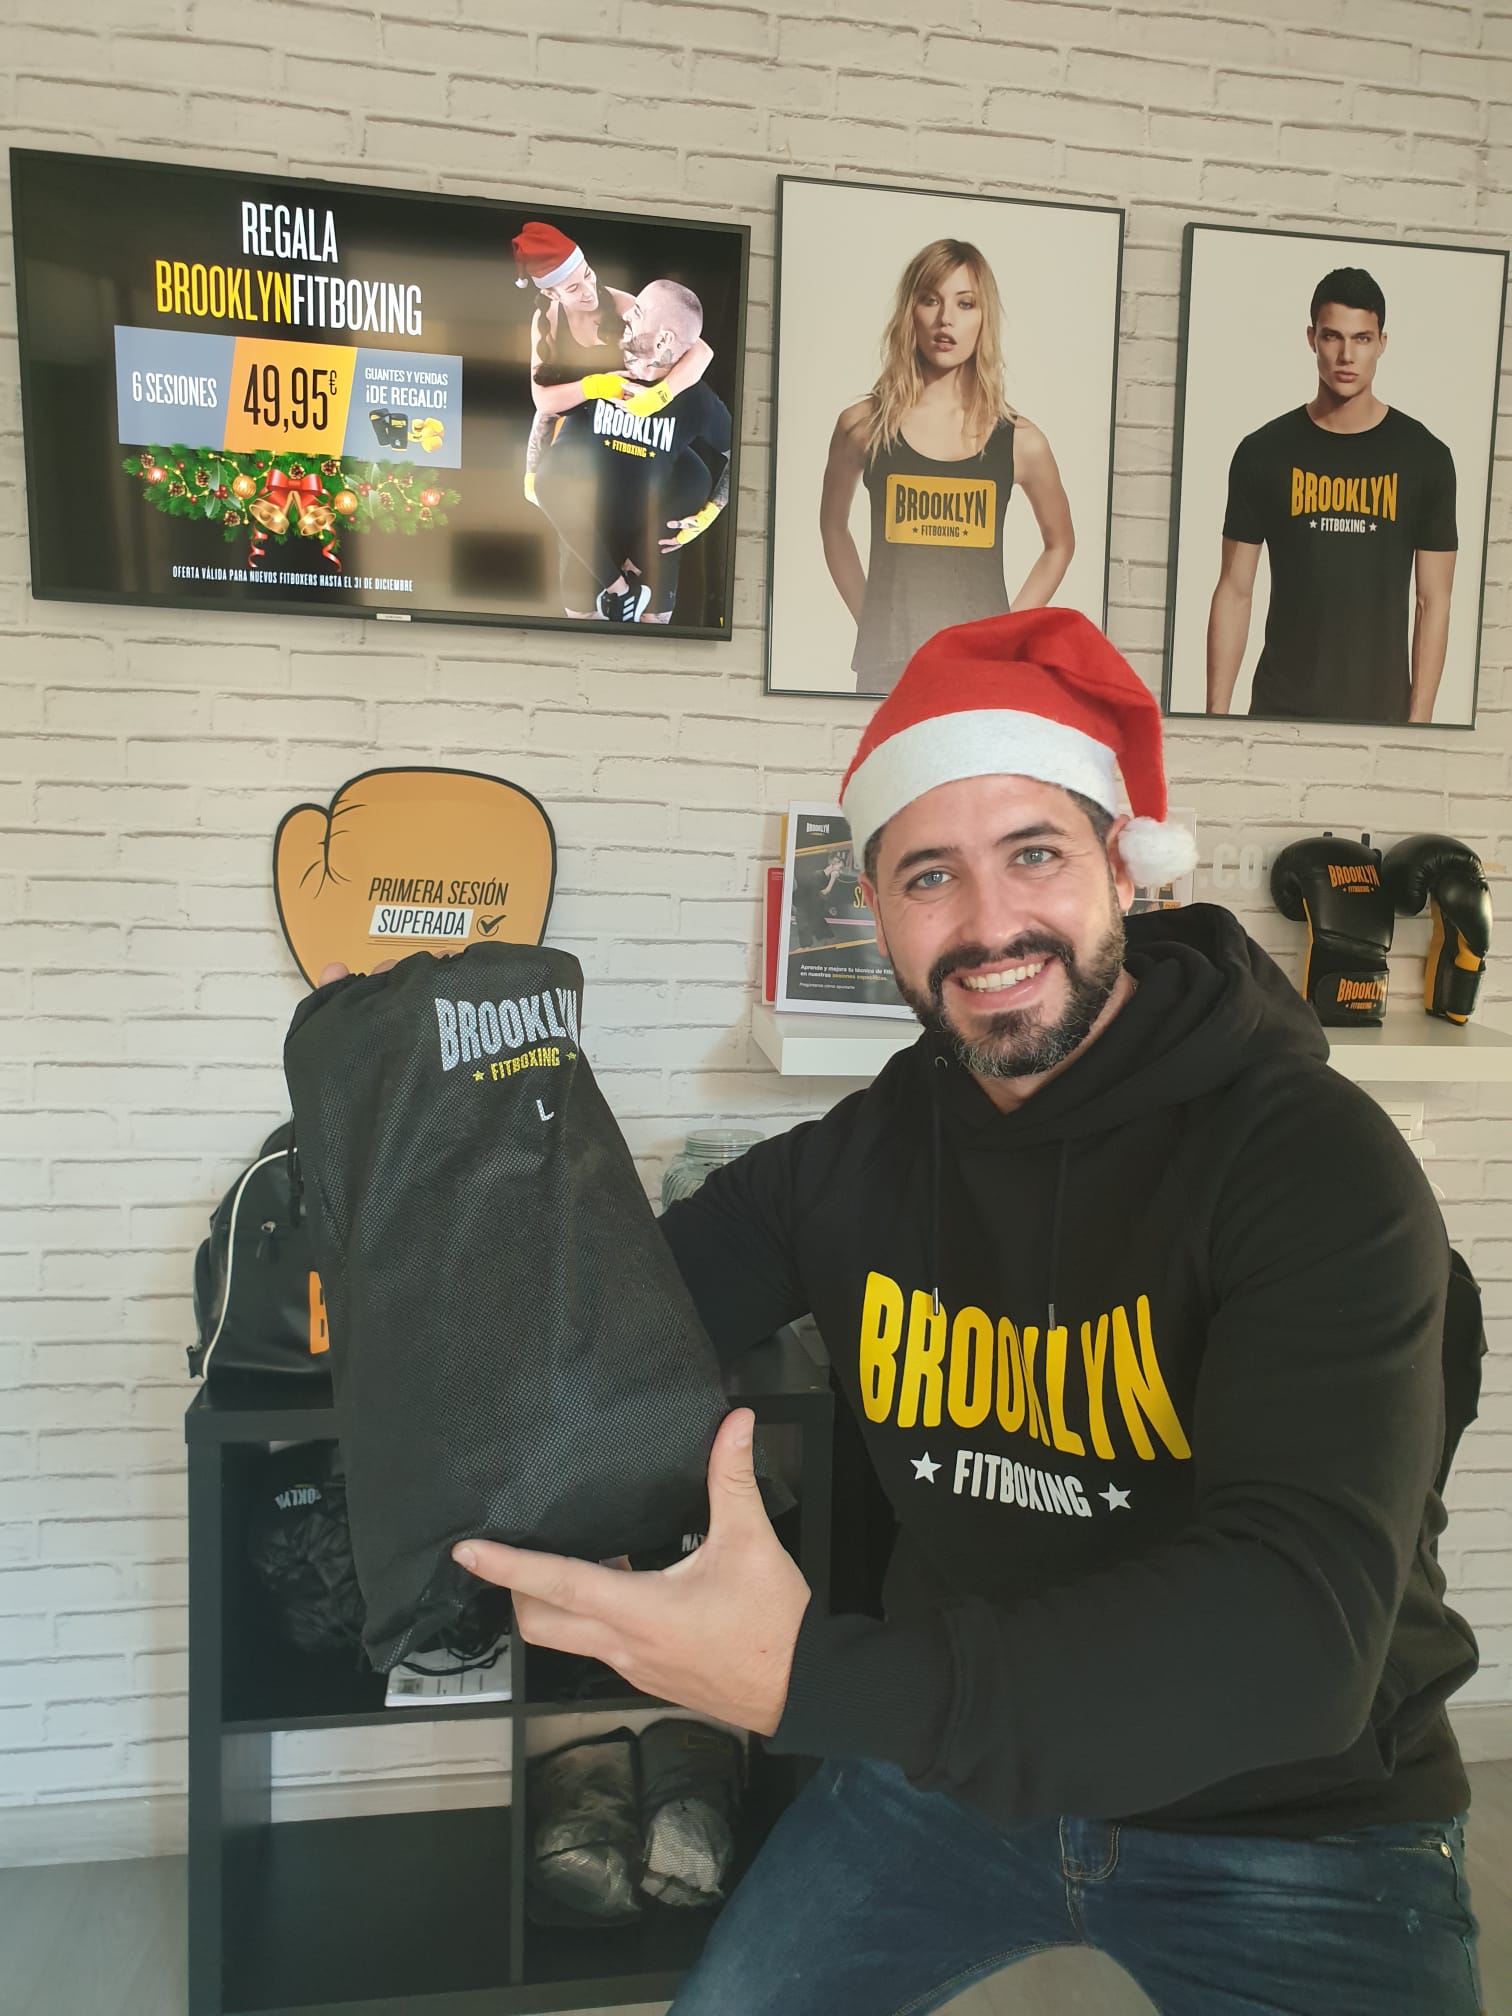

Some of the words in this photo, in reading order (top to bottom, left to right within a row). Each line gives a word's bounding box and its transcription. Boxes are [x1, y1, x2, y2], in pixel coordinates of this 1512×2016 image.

[241, 201, 339, 264] REGALA
[132, 371, 142, 401] 6
[146, 371, 218, 408] SESIONES
[364, 367, 405, 384] GUANTES
[406, 370, 413, 383] Y
[413, 370, 449, 386] VENDAS
[365, 384, 389, 405] ¡DE
[391, 386, 448, 409] REGALO!
[593, 398, 676, 452] BROOKLYN
[611, 439, 648, 458] FITBOXING
[895, 483, 988, 529] BROOKLYN
[1291, 466, 1398, 522] BROOKLYN
[920, 525, 960, 538] FITBOXING
[1320, 517, 1366, 533] FITBOXING
[172, 565, 200, 579] OFERTA
[201, 565, 227, 581] VÁLIDA
[229, 568, 248, 582] PARA
[249, 570, 278, 584] NUEVOS
[279, 571, 318, 586] FITBOXERS
[319, 574, 342, 588] HASTA
[343, 575, 353, 588] EL
[354, 576, 362, 589] 31
[363, 576, 373, 590] DE
[374, 577, 413, 592] DICIEMBRE
[1328, 864, 1381, 888] BROOKLYN
[368, 877, 444, 904] PRIMERA
[447, 876, 510, 906] SESIÓN
[377, 908, 466, 936] SUPERADA
[1337, 978, 1387, 1002] BROOKLYN
[435, 987, 579, 1072] BROOKLYN
[490, 1047, 561, 1081] FITBOXING
[536, 1099, 555, 1122] L
[859, 1271, 1192, 1461] BROOKLYN
[953, 1449, 1093, 1518] FITBOXING
